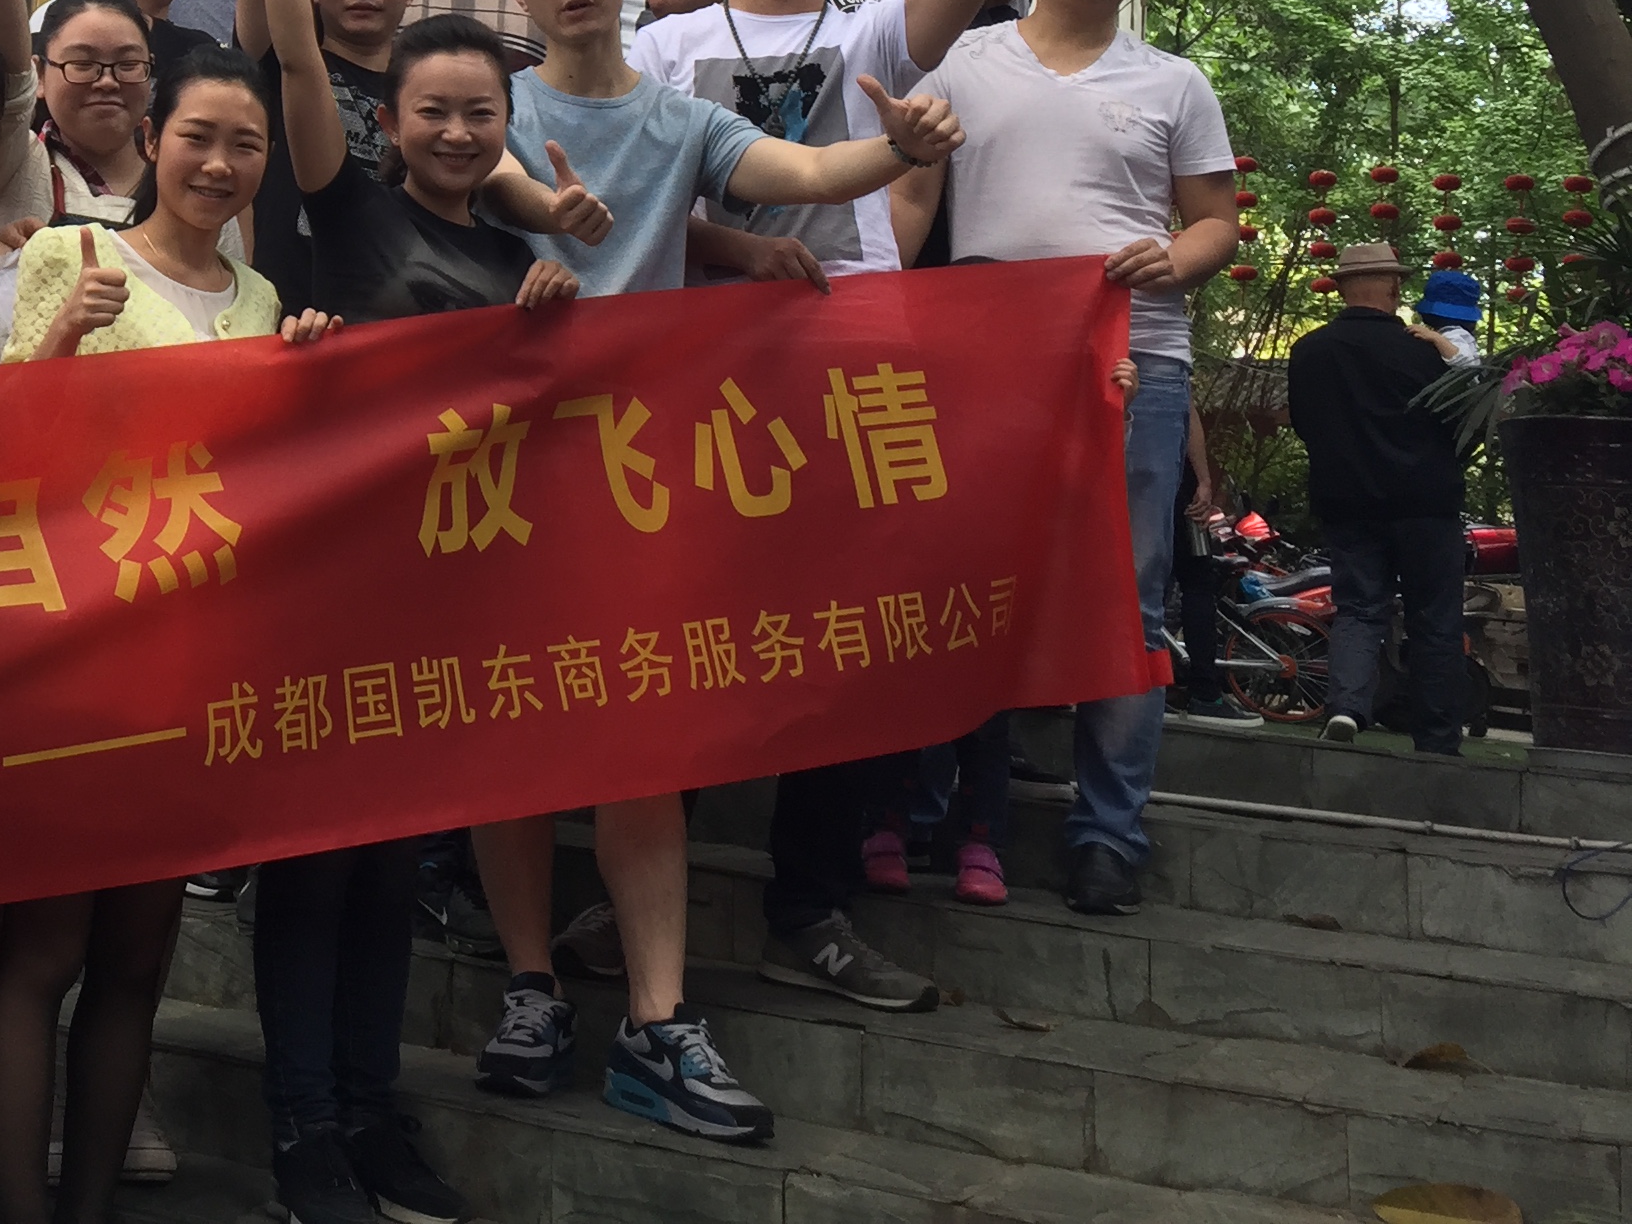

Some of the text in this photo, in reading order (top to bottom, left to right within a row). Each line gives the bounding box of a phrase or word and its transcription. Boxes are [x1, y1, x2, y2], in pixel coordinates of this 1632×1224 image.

[417, 362, 949, 558] 放飞心情
[812, 942, 855, 976] N
